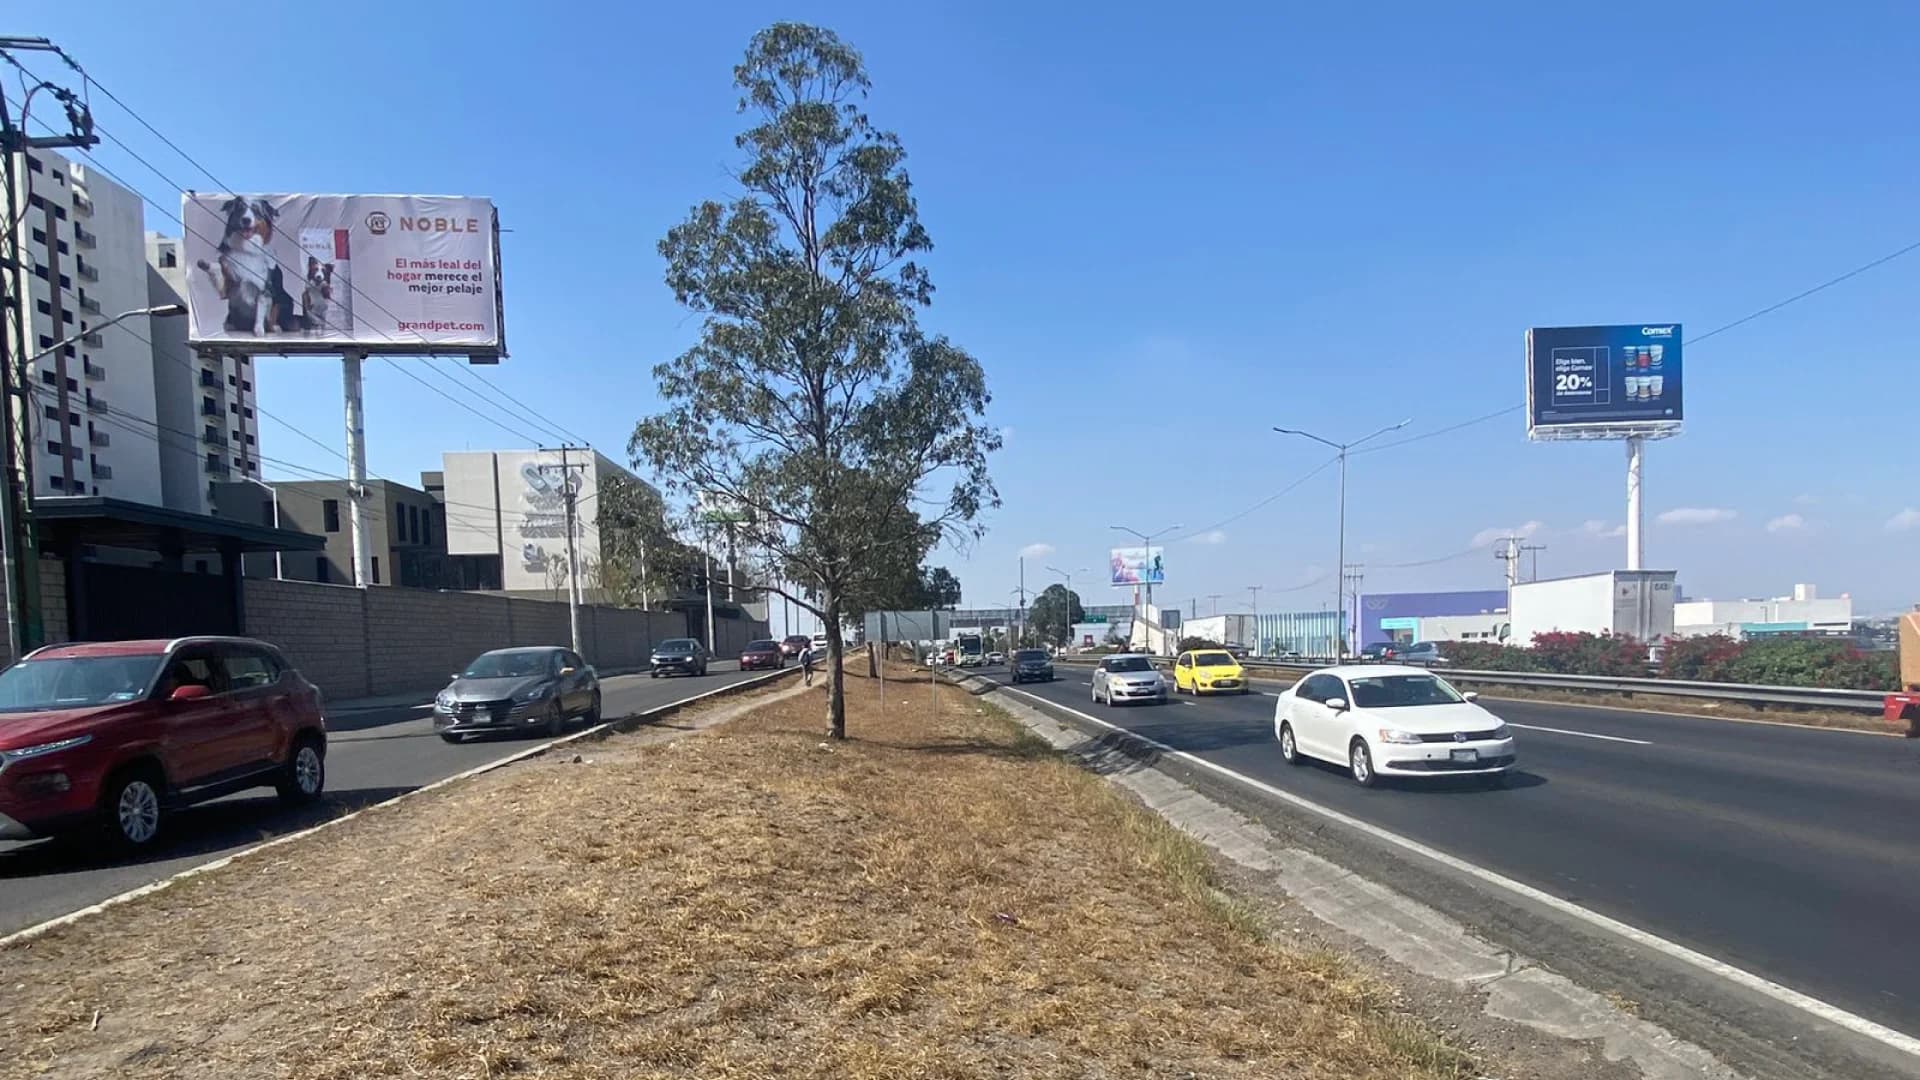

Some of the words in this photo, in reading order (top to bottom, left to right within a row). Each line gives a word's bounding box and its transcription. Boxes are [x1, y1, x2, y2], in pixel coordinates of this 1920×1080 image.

[400, 217, 479, 232] NOBLE
[395, 258, 407, 269] El
[410, 258, 436, 270] más
[438, 259, 461, 270] leal
[463, 260, 482, 270] del
[387, 270, 422, 283] hogar
[425, 273, 468, 281] merece
[471, 272, 482, 282] el
[408, 283, 444, 294] mejor
[446, 284, 483, 295] pelaje
[398, 320, 485, 332] grandpet.com
[1555, 374, 1593, 391] 20%
